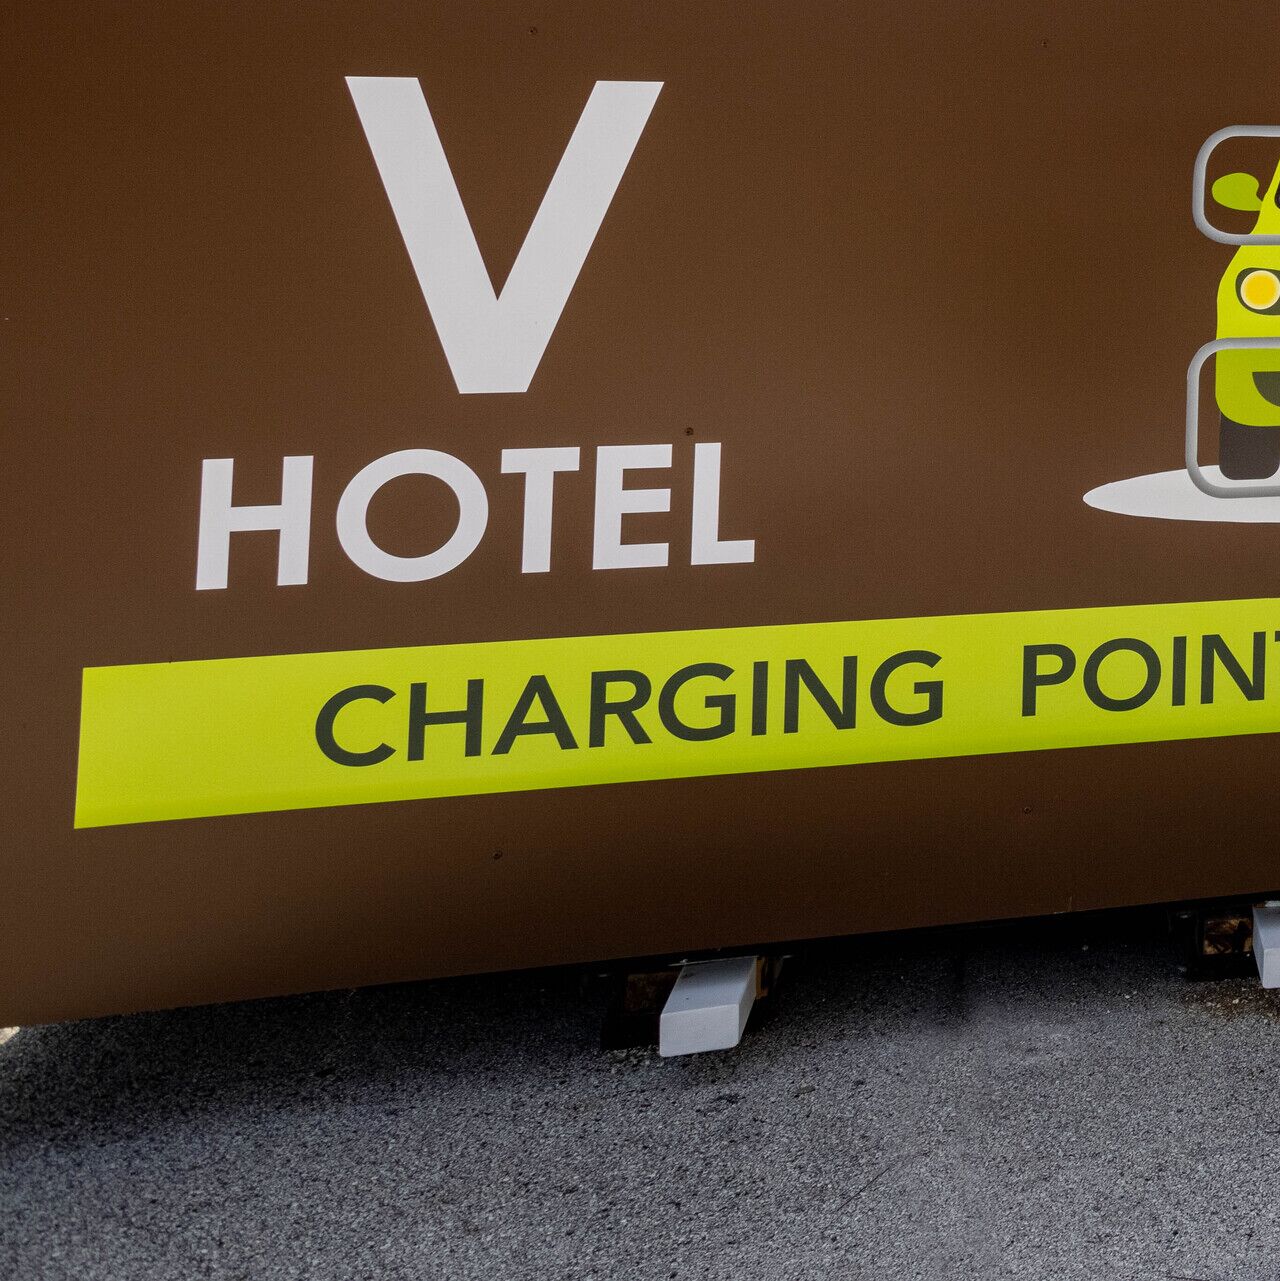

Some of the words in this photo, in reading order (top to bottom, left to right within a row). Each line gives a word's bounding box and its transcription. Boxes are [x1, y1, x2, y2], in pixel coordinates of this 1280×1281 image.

[345, 76, 664, 394] V
[195, 442, 756, 591] HOTEL
[314, 649, 944, 768] CHARGING
